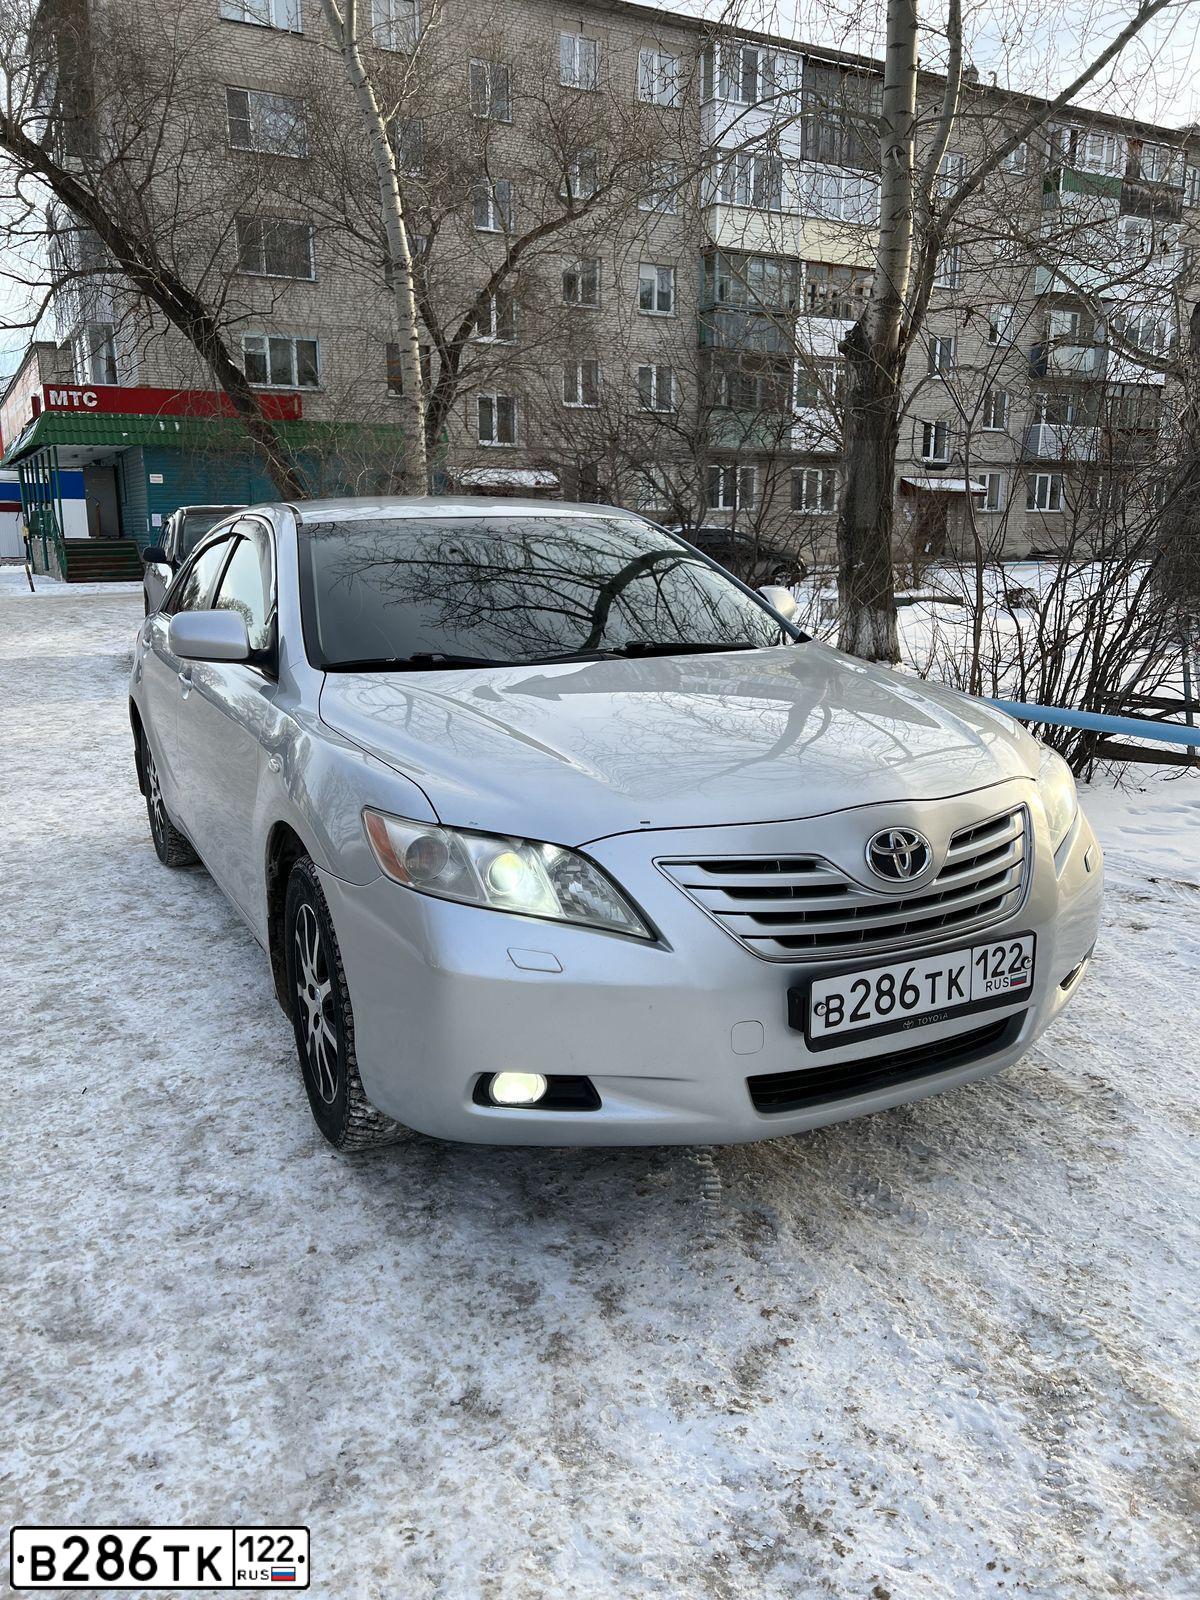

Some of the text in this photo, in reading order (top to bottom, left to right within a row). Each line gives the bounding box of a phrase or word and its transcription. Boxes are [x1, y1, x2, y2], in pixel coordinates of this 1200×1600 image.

[49, 389, 98, 407] МТС
[976, 942, 1023, 980] 122
[985, 976, 1009, 992] RUS
[917, 1012, 948, 1025] TOYOTA
